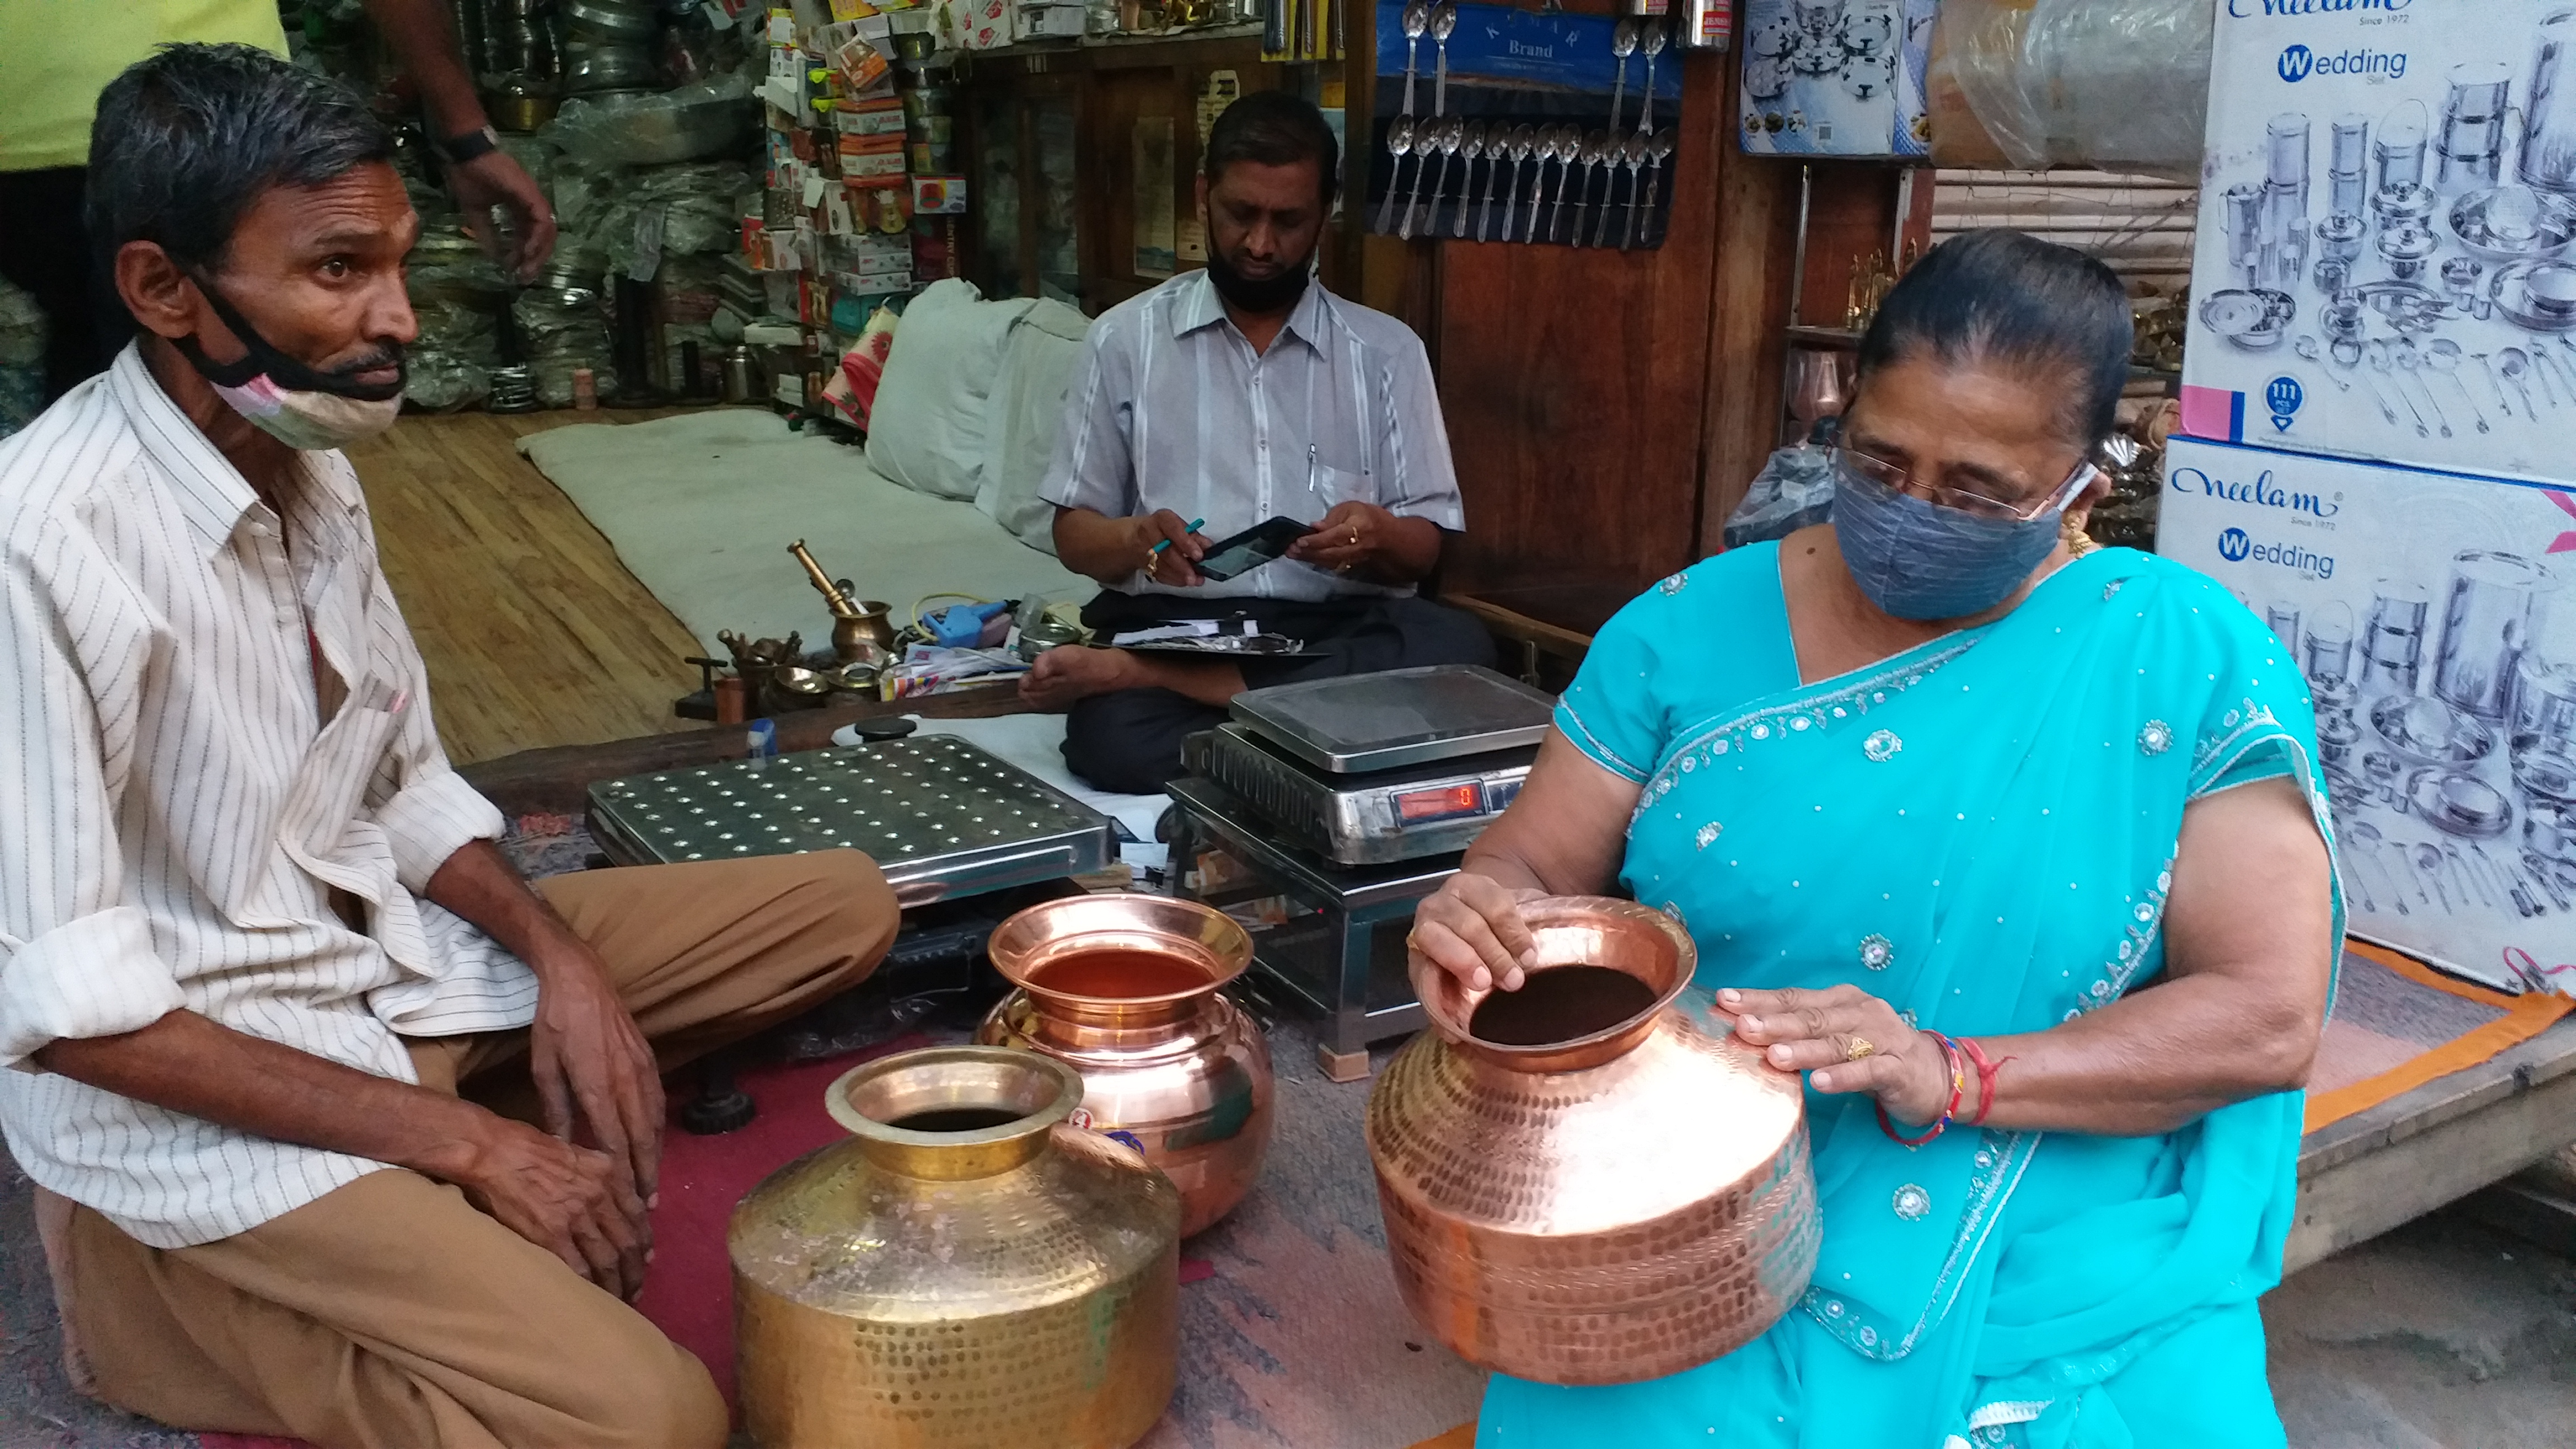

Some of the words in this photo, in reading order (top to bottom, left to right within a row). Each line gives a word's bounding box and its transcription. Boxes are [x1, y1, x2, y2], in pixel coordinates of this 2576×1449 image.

[2359, 17, 2383, 26] Since
[2387, 15, 2409, 24] 1972
[1509, 39, 1554, 58] Brand
[2280, 47, 2407, 79] Wedding
[2273, 382, 2296, 400] 111
[2290, 516, 2312, 528] Since
[2315, 519, 2336, 532] 1972
[2219, 529, 2334, 580] Wedding
[1460, 788, 1471, 806] 0
